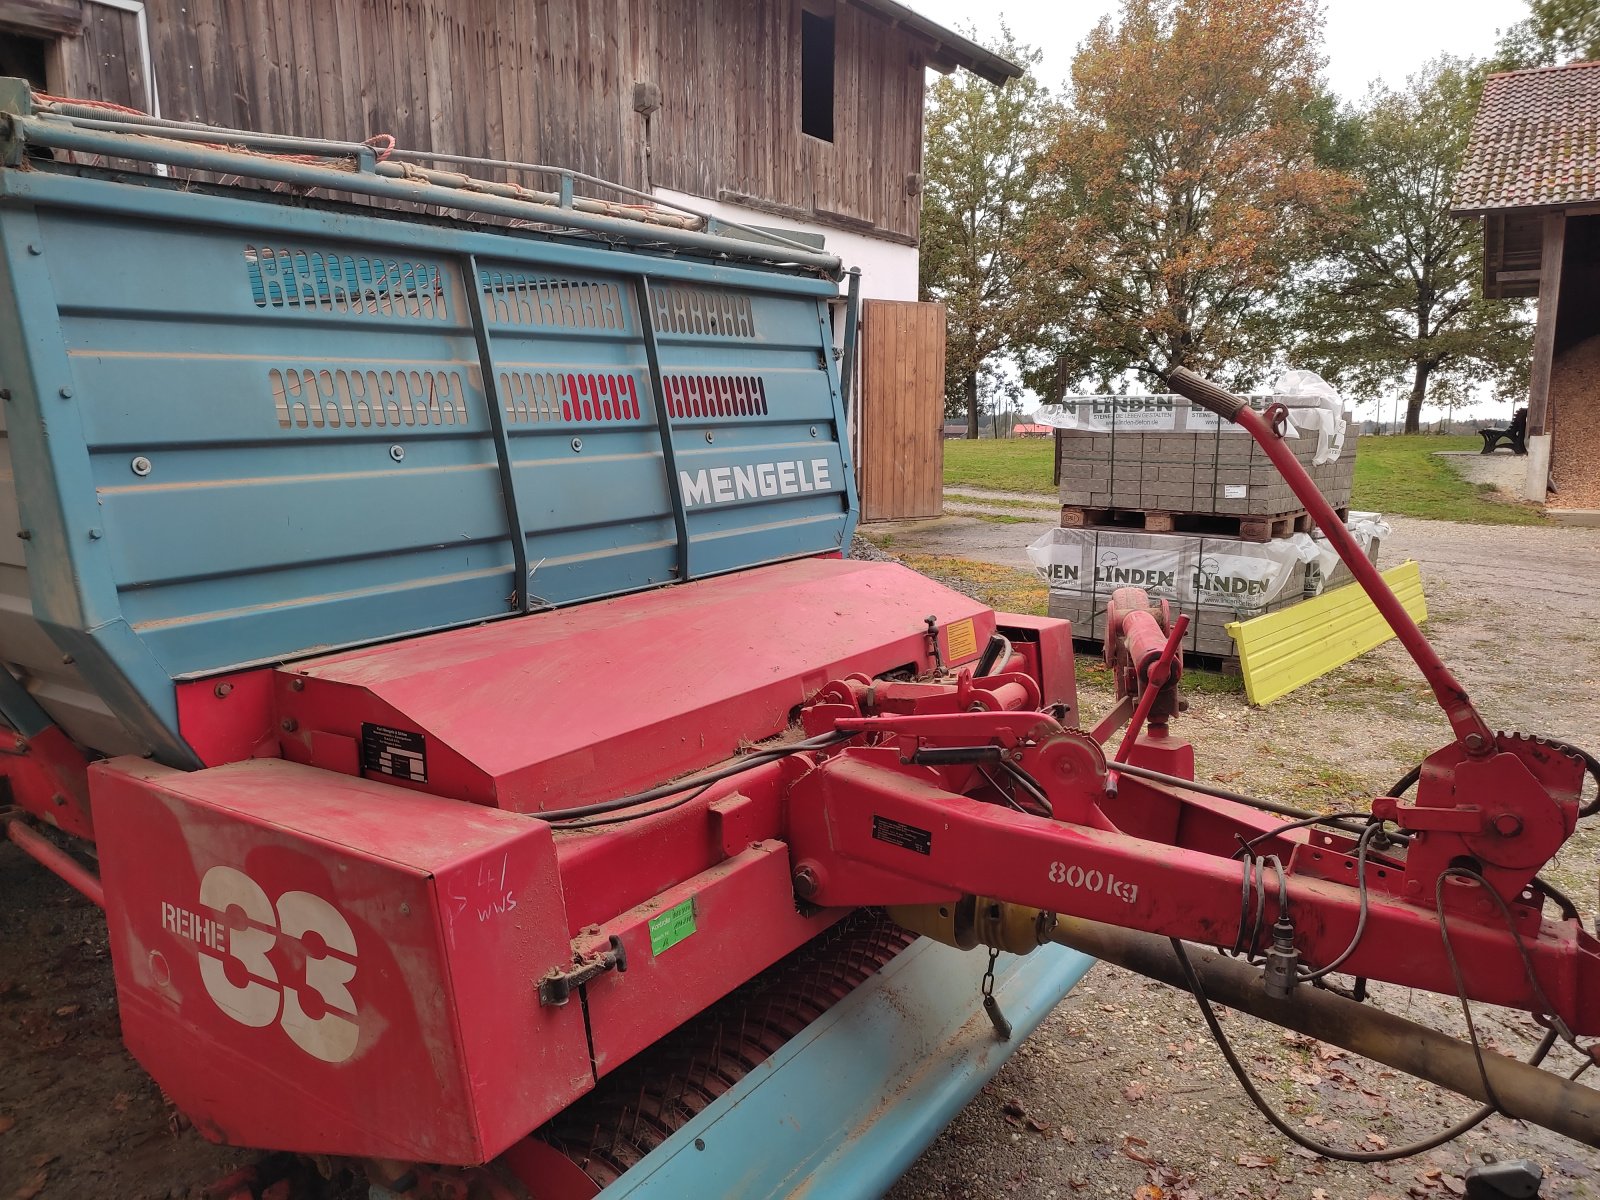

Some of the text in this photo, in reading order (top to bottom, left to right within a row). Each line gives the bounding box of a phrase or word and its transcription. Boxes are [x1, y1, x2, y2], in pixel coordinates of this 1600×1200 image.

[1093, 396, 1173, 413] LINDEN
[679, 458, 832, 507] MENGELE
[1095, 566, 1174, 587] LINDEN
[1192, 573, 1270, 596] LINDEN
[161, 865, 360, 1063] REIHE 33
